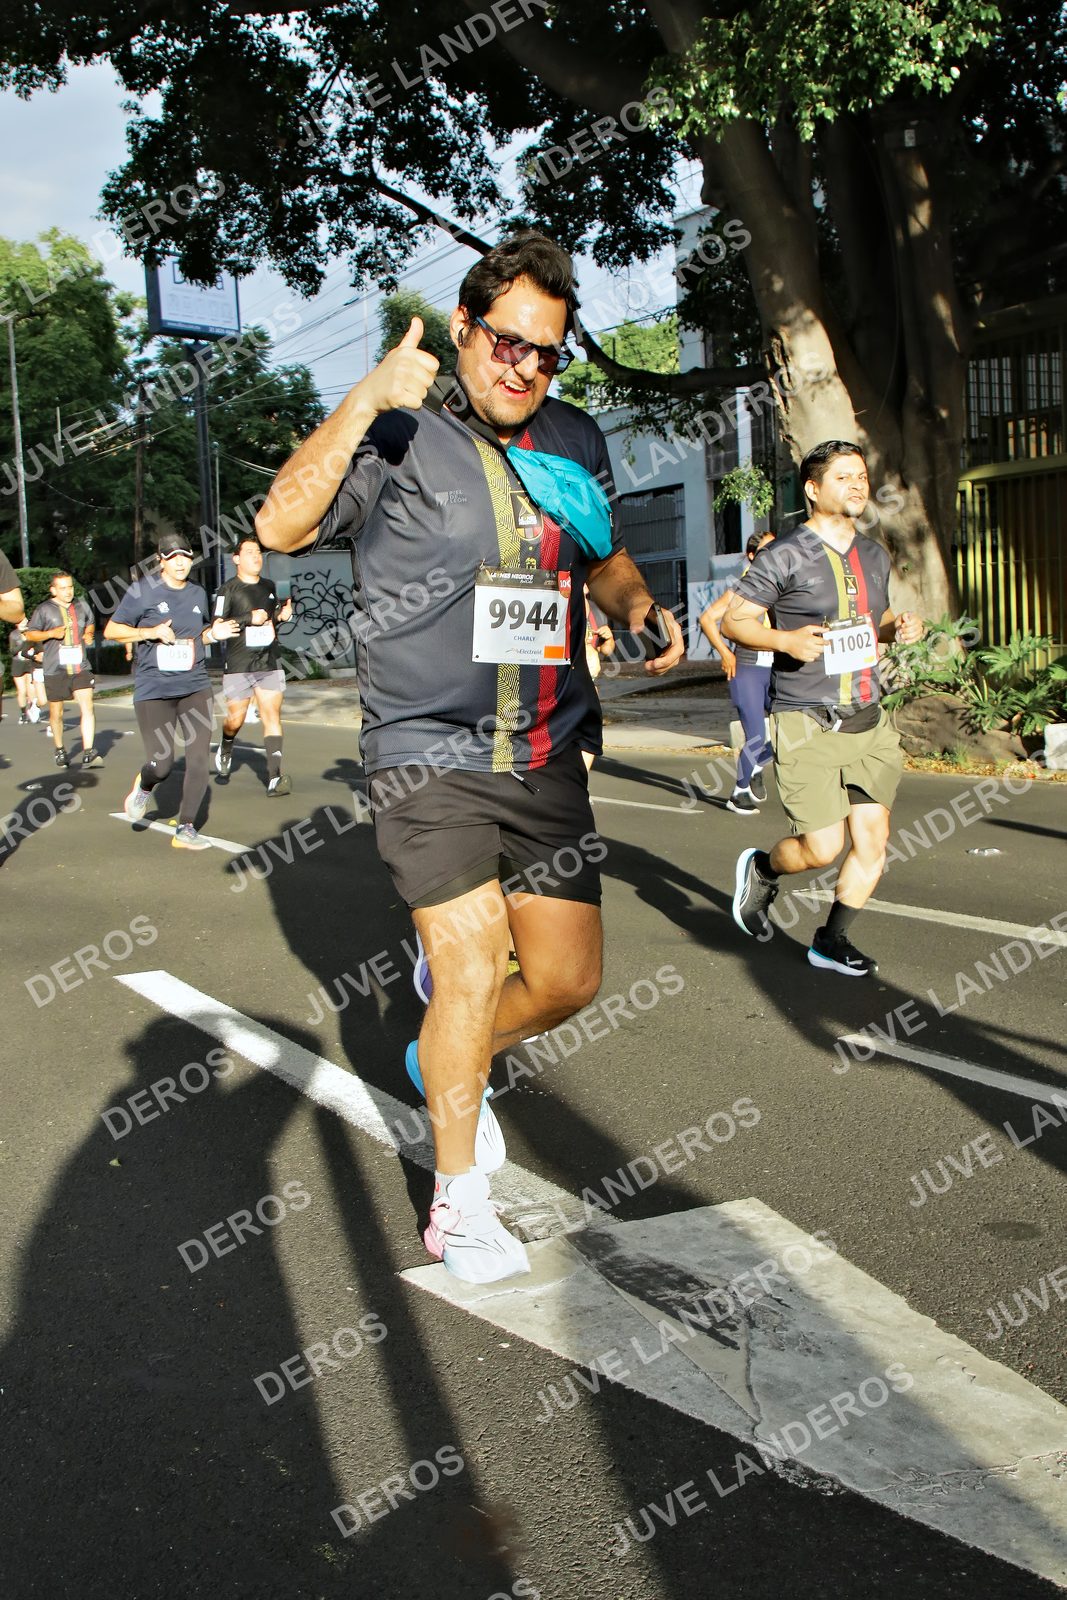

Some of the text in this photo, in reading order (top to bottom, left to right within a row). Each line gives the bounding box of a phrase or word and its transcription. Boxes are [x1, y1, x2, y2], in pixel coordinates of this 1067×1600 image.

[290, 569, 331, 585] TOY
[489, 599, 558, 631] 9944
[829, 631, 872, 654] 11002
